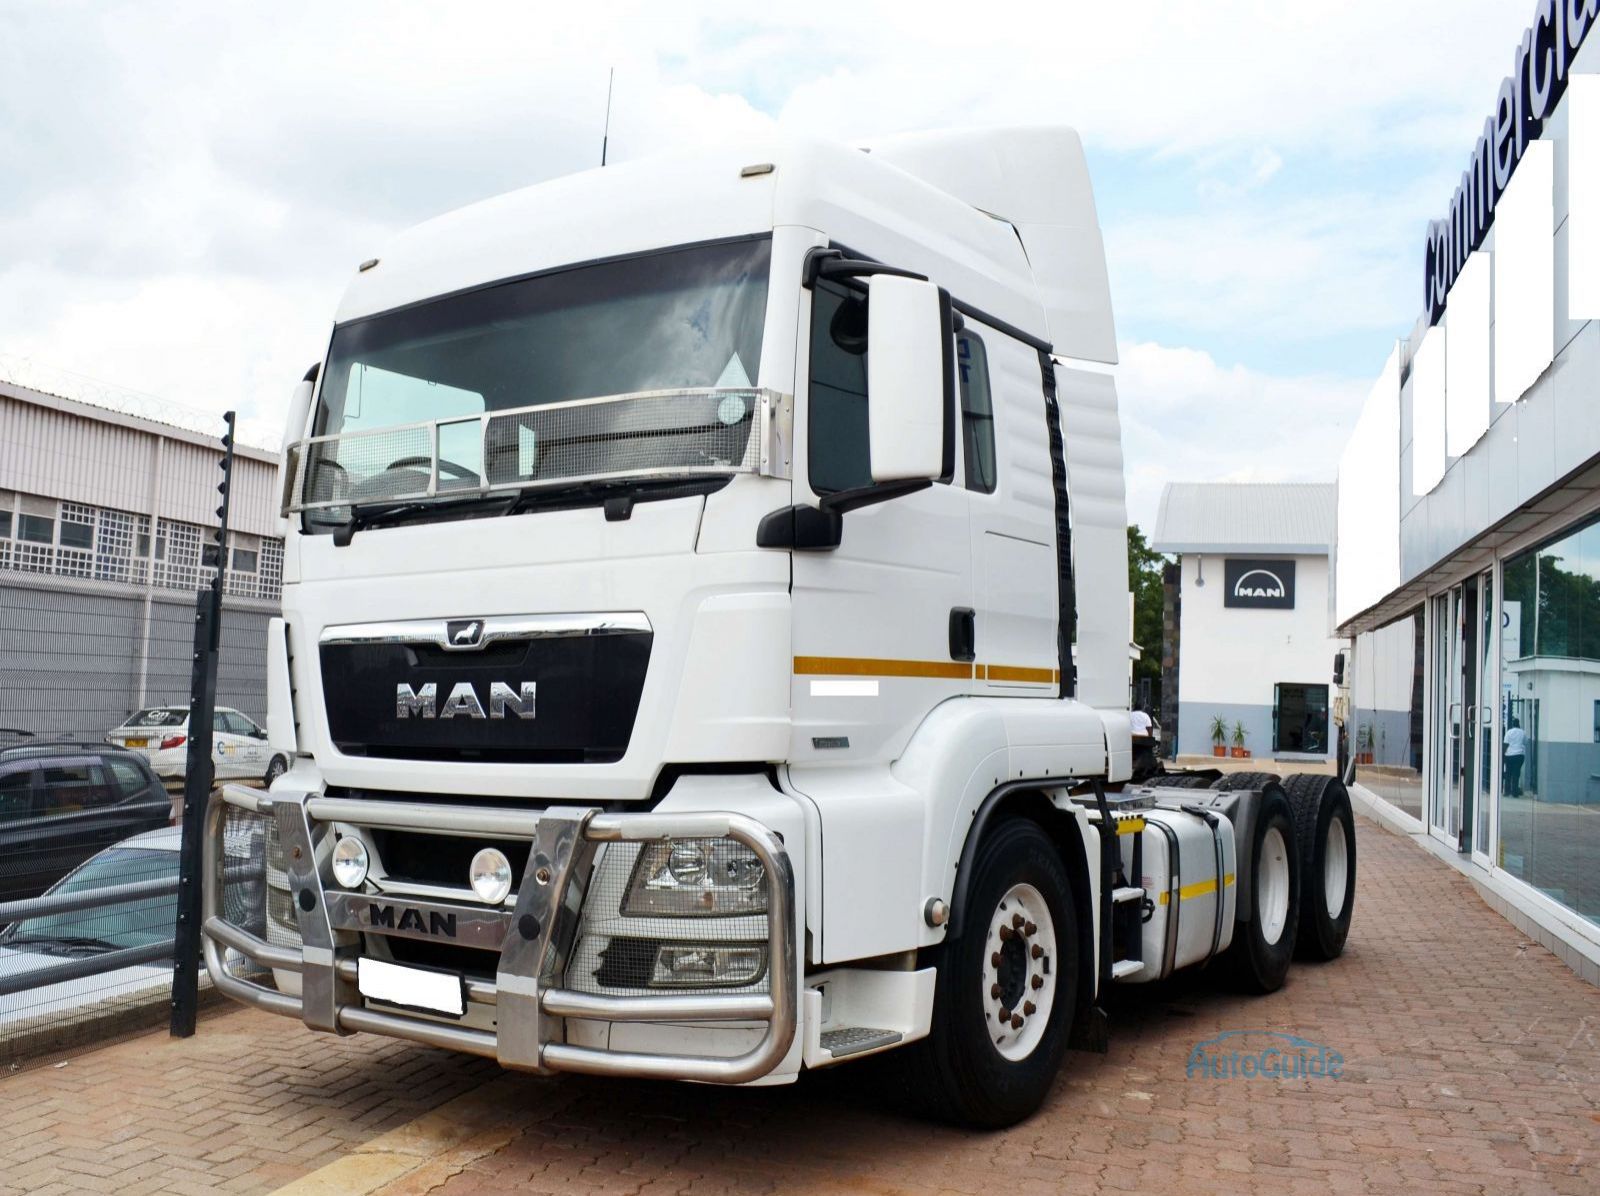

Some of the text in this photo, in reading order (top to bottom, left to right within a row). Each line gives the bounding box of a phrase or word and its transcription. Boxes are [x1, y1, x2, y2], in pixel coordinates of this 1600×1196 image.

[1239, 587, 1281, 597] MAN
[396, 681, 537, 720] MAN
[369, 903, 457, 938] MAN
